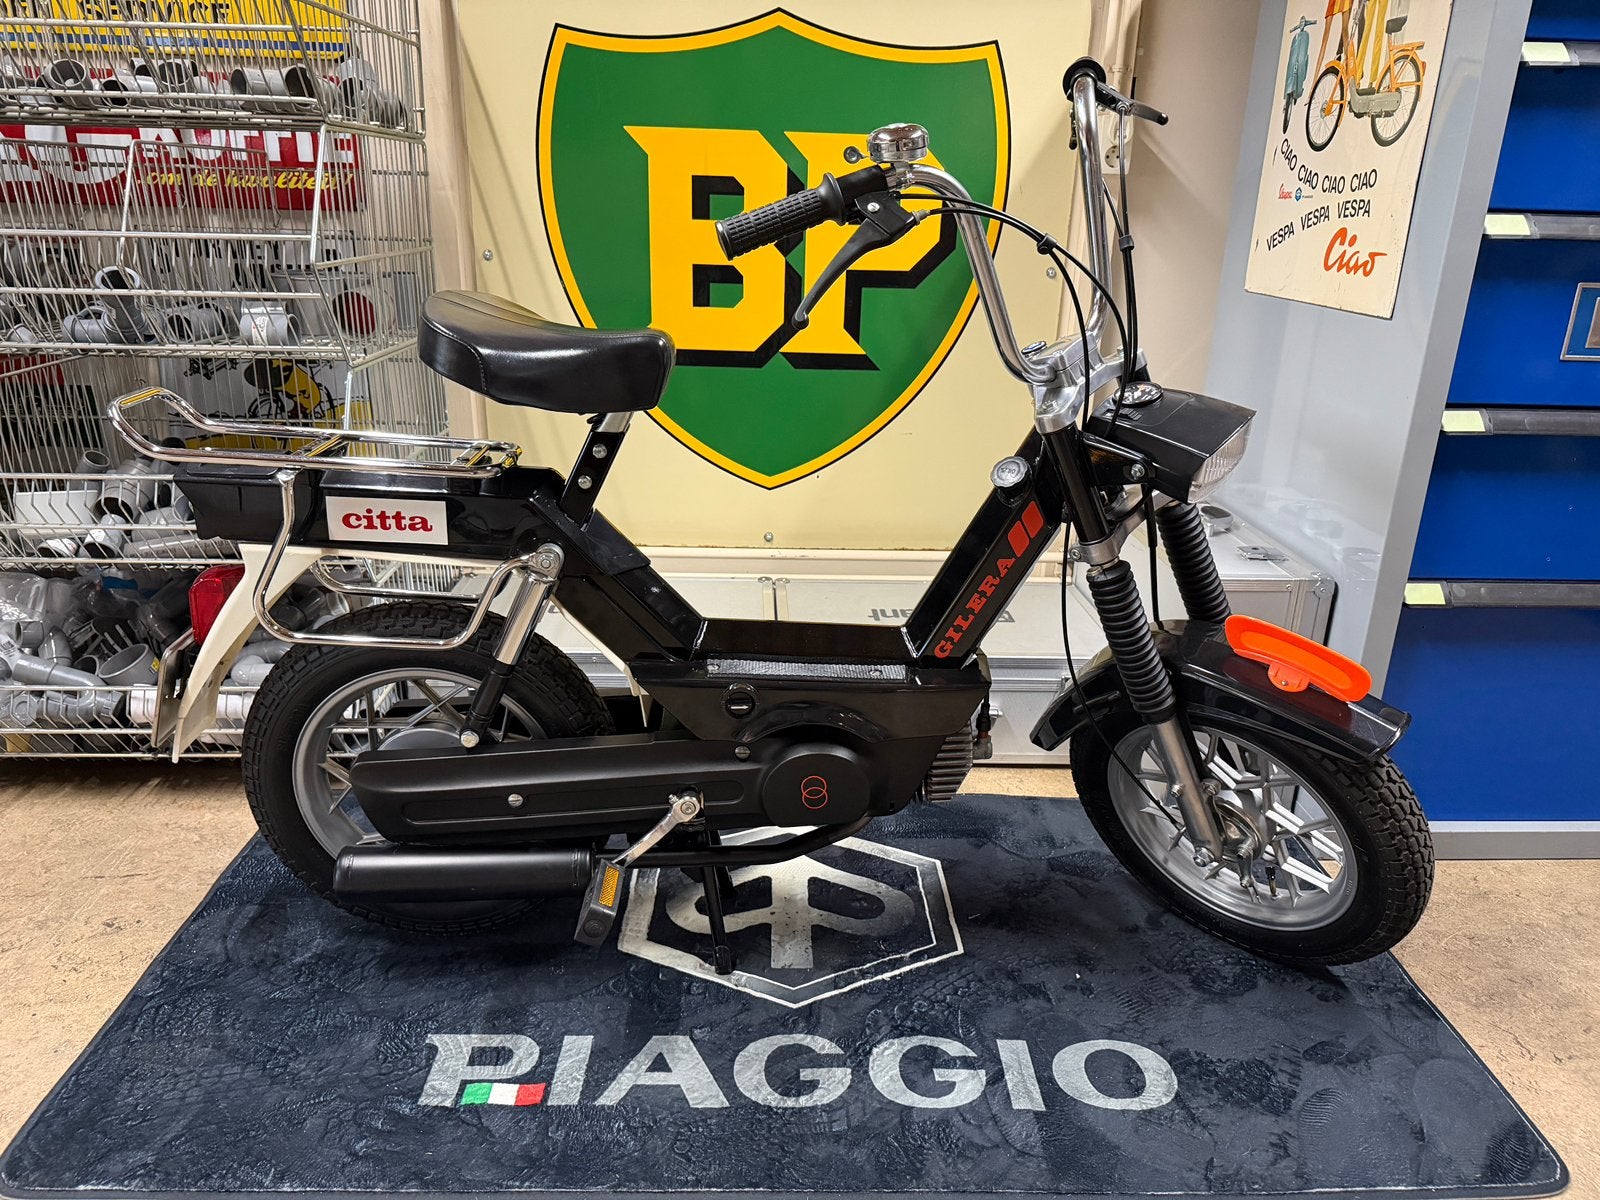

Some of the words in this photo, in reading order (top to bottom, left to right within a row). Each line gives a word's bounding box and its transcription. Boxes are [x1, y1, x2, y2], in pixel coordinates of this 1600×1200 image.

[1280, 138, 1298, 171] CIAO
[1298, 164, 1319, 190] CIAO
[1321, 175, 1346, 194] CIAO
[1350, 168, 1378, 193] CIAO
[623, 126, 957, 370] BP
[1266, 221, 1295, 251] VESPA
[1300, 205, 1330, 231] VESPA
[1337, 199, 1371, 219] VESPA
[1323, 227, 1388, 277] Ciao
[341, 508, 433, 532] citta
[934, 557, 1016, 659] GILERA
[417, 1033, 1178, 1111] PIAGGIO
